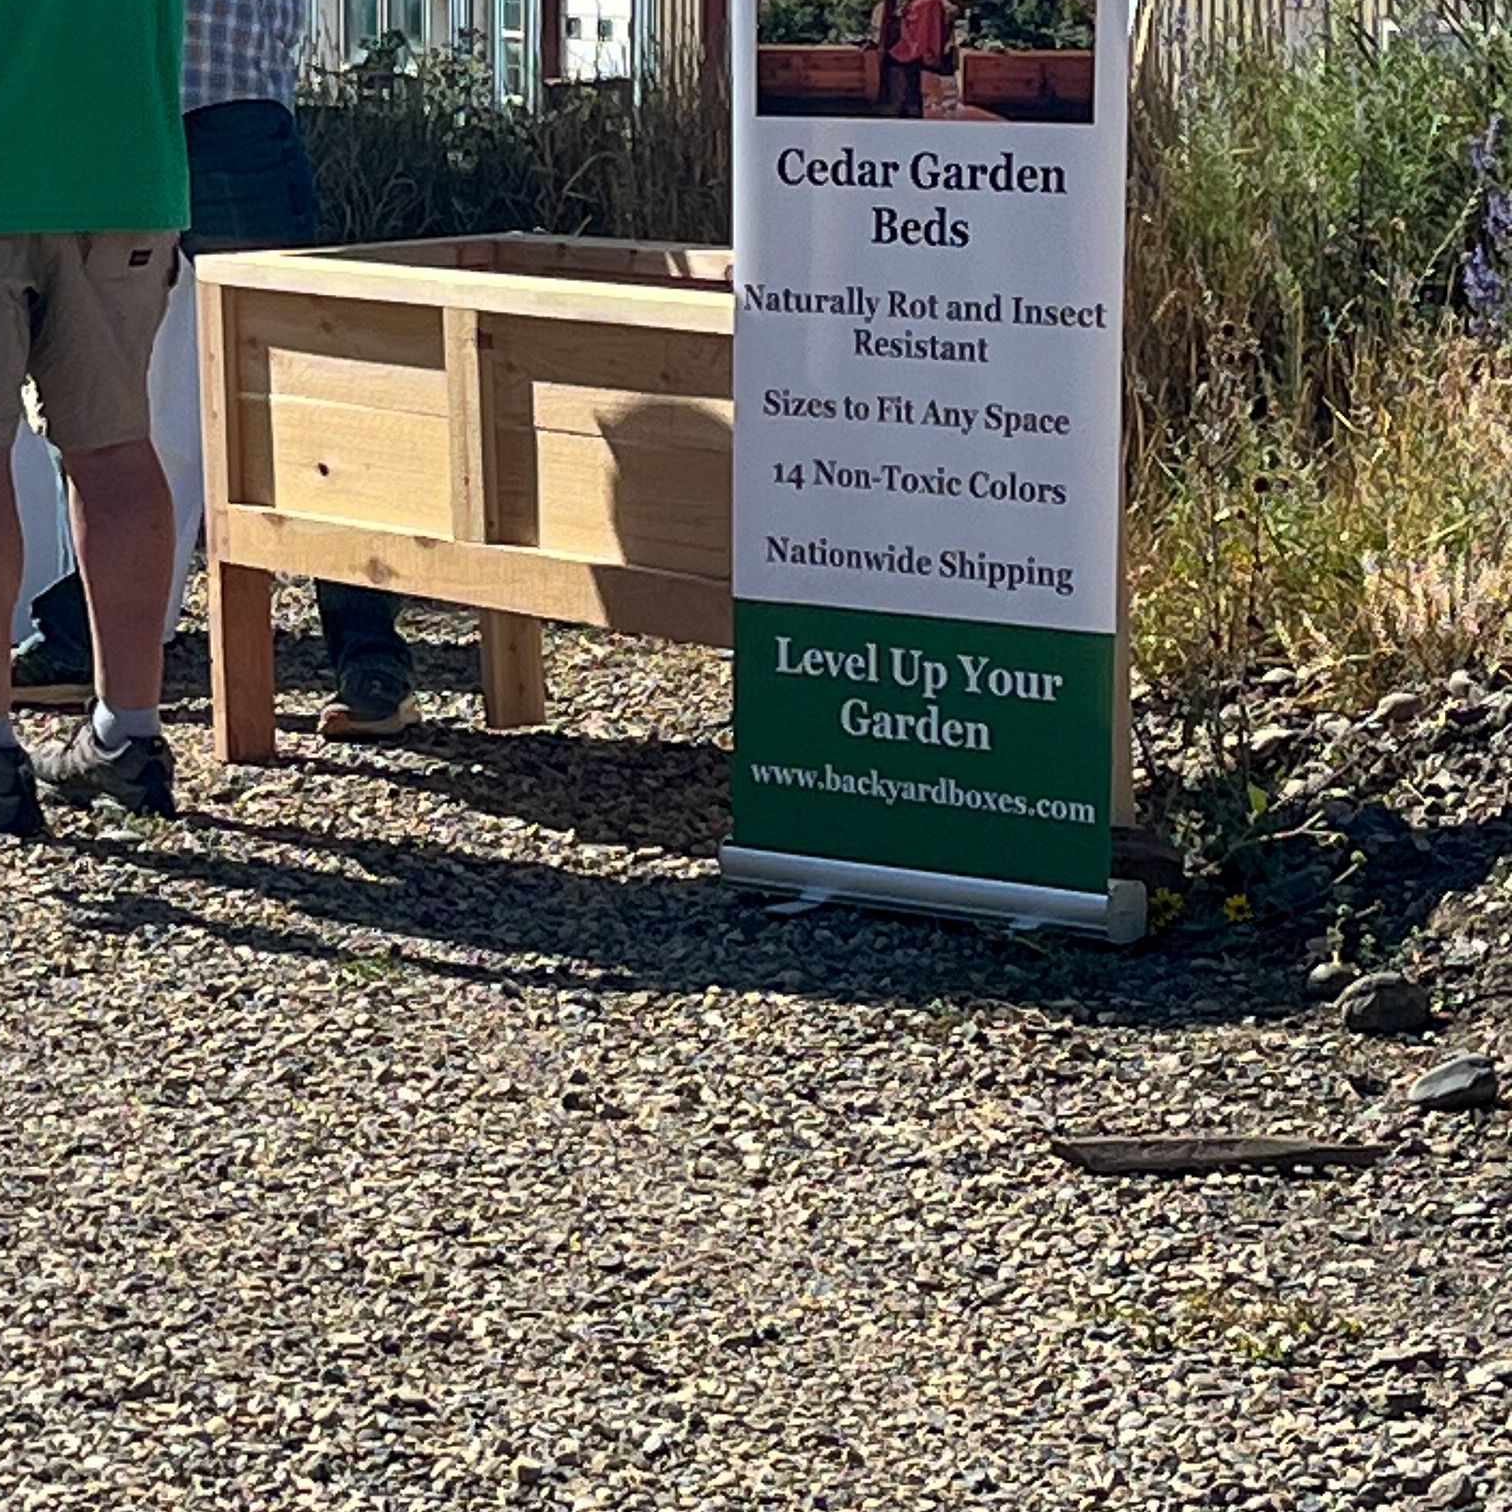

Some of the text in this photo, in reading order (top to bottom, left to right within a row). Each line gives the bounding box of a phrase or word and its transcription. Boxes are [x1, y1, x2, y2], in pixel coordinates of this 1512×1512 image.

[777, 147, 1068, 194] Cedar Garden
[871, 206, 971, 248] Beds
[743, 284, 1108, 329] Naturally Rot and Insect
[854, 328, 989, 363] Resistant
[763, 389, 1071, 438] Sizes to Fit Any Space
[772, 458, 1068, 505] 14 Non-Toxic Colors
[766, 536, 1074, 596] Nationwide Shipping
[775, 635, 1064, 701] Level Up Your
[840, 697, 991, 751] Garden
[750, 763, 1097, 824] www.backyardboxes.com
